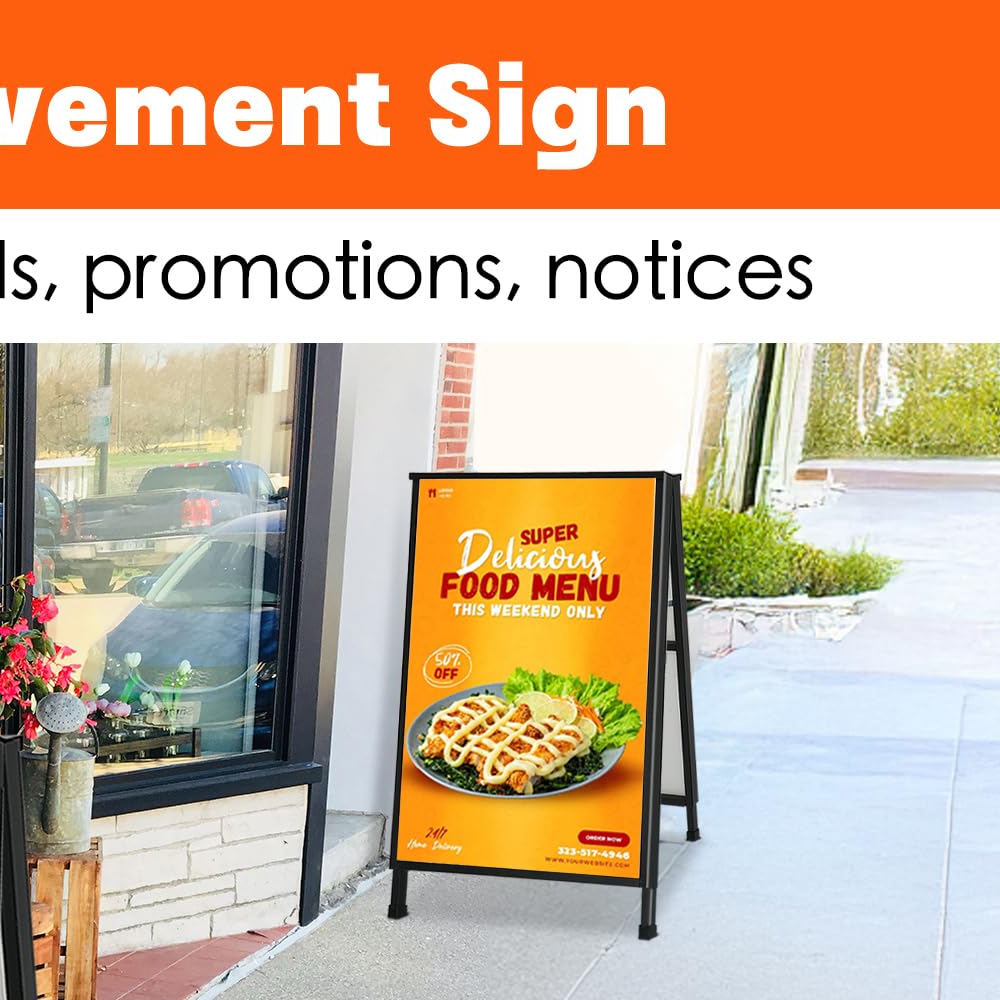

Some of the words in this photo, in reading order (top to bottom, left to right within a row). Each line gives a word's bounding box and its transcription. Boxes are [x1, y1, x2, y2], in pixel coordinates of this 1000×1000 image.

[520, 524, 578, 546] SUPER
[456, 529, 606, 581] Delicious
[440, 572, 520, 600] FOOD
[531, 574, 620, 602] MENU
[453, 603, 485, 617] THIS
[490, 604, 561, 618] WEEKEND
[566, 605, 606, 620] ONLY
[435, 652, 461, 667] 50%
[434, 668, 459, 680] OFF
[585, 834, 606, 842] ORDER
[557, 847, 630, 860] 323-517-4946
